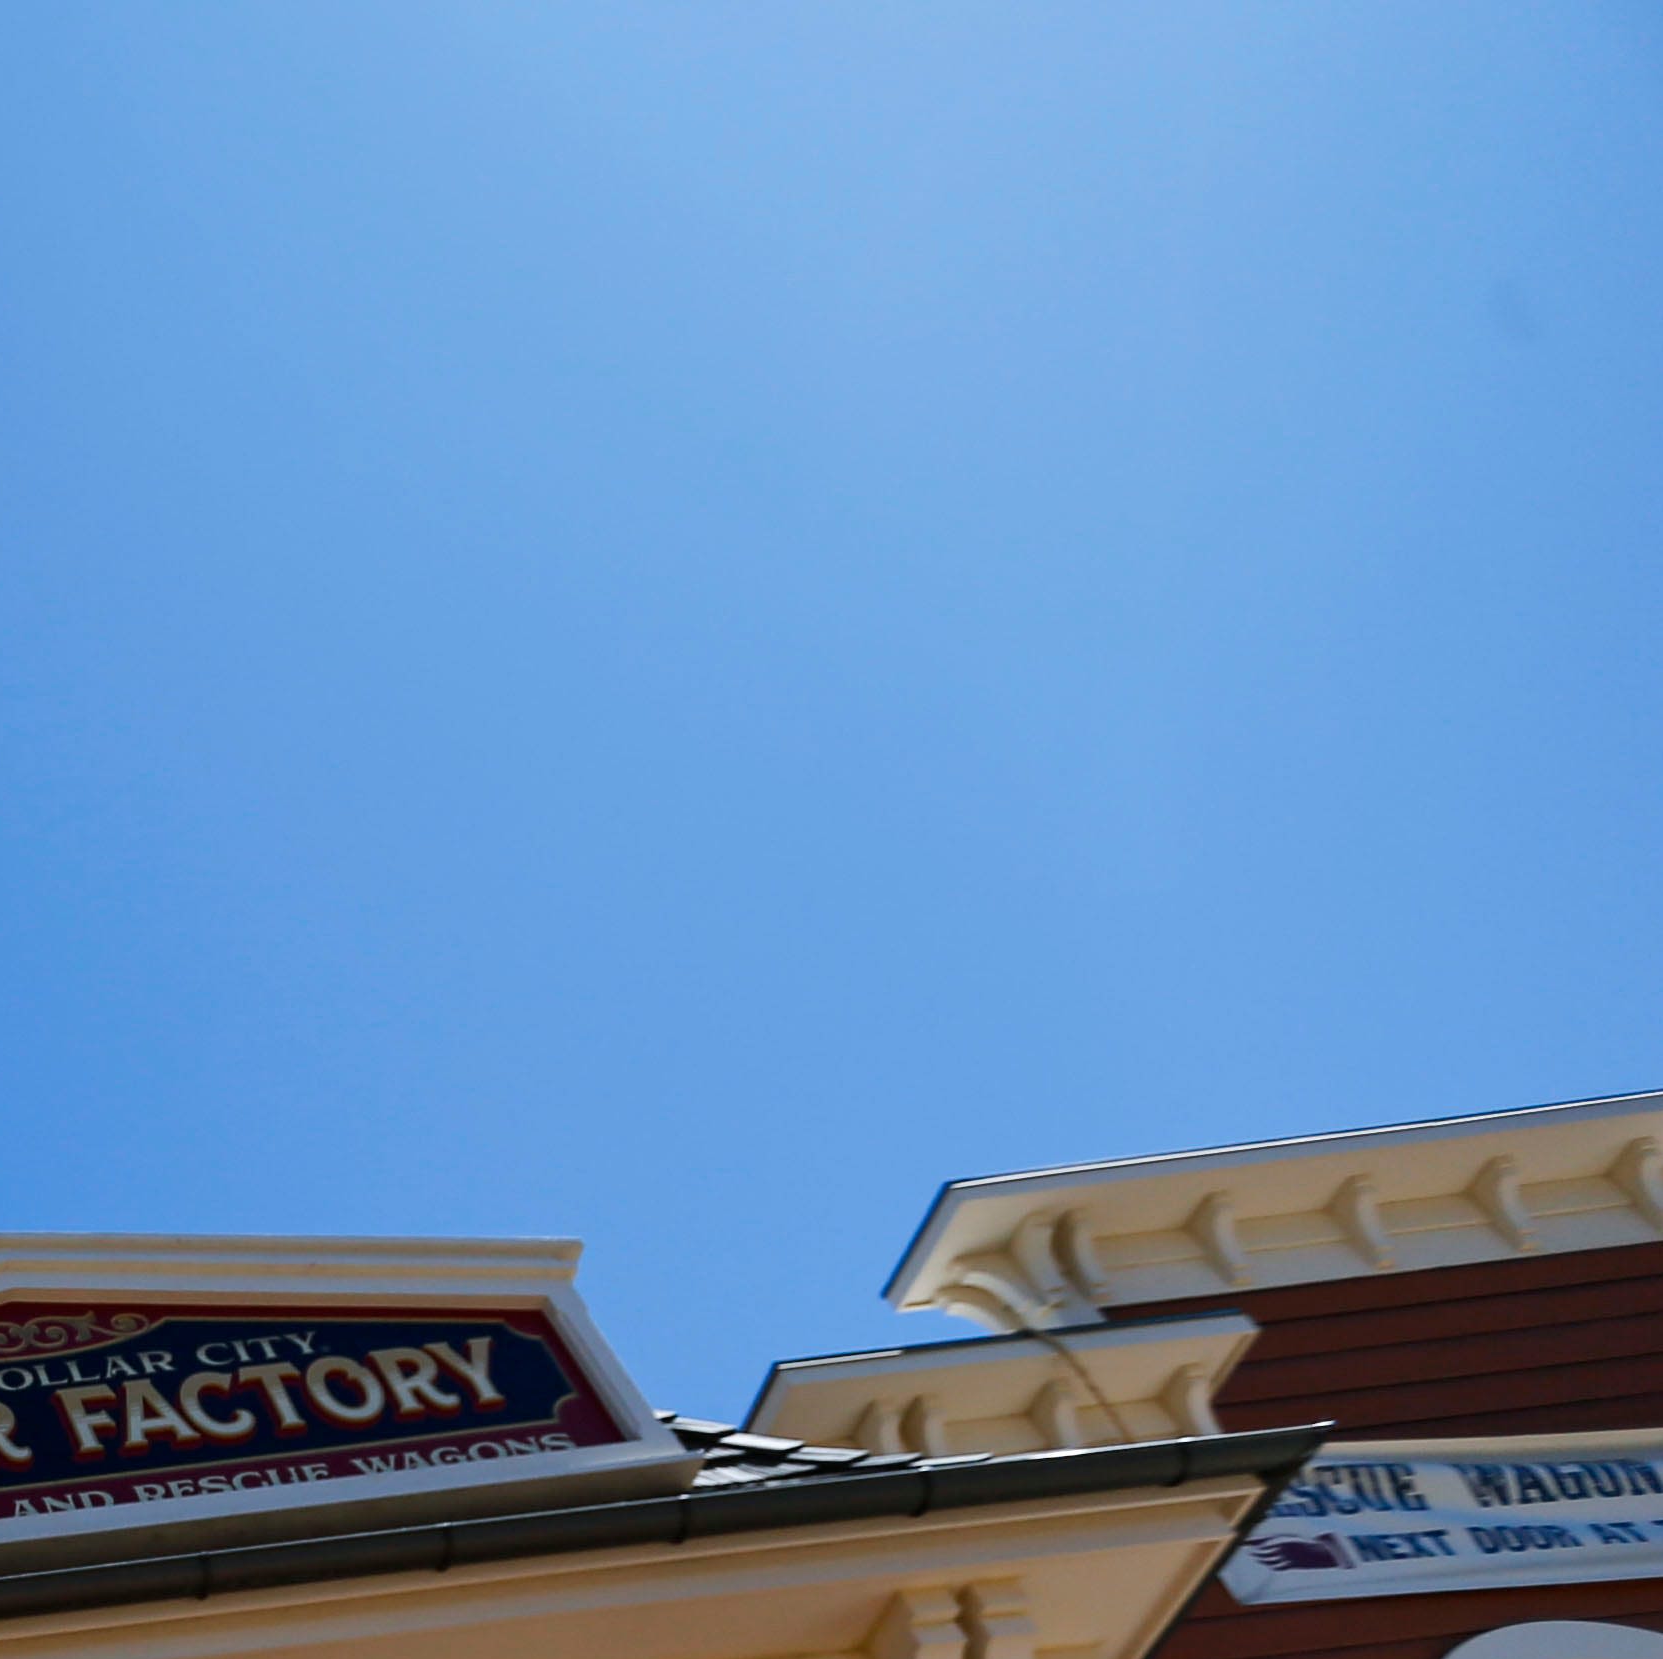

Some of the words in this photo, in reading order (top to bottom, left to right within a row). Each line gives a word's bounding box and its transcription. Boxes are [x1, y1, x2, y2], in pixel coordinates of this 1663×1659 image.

[195, 1331, 317, 1367] CITY
[55, 1336, 505, 1460] FACTORY
[1347, 1529, 1456, 1562] NEXT
[1466, 1525, 1584, 1553] DOOR
[1588, 1521, 1649, 1545] AT
